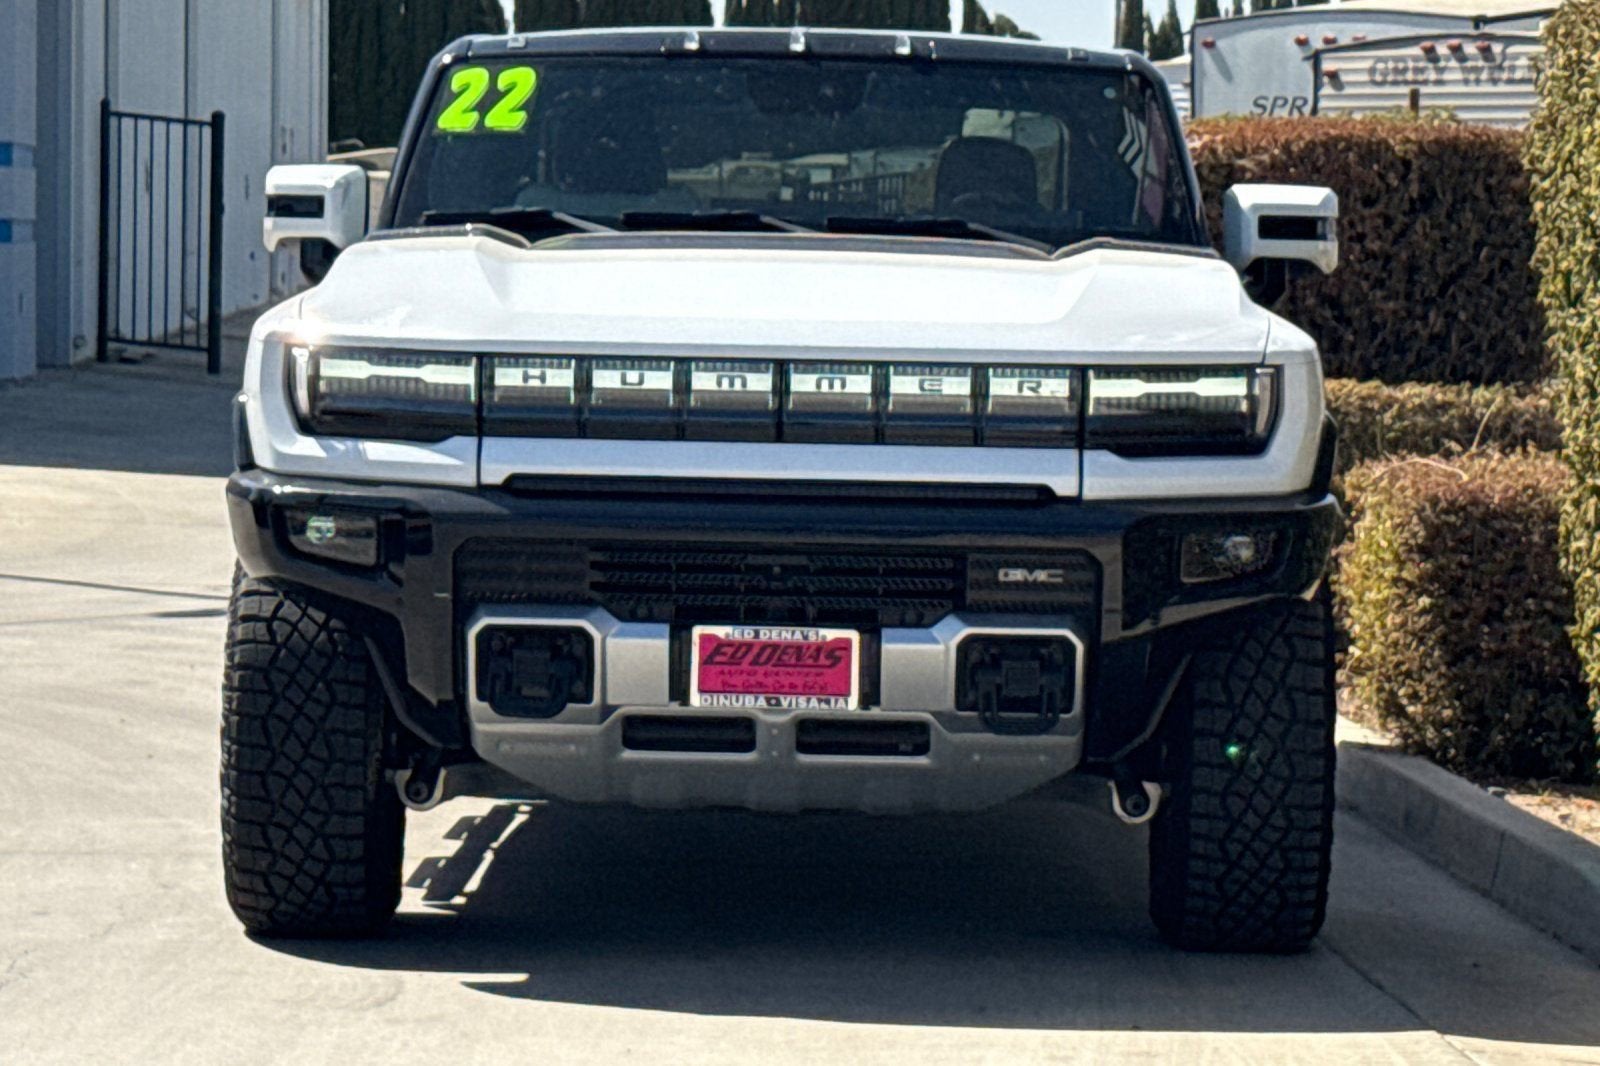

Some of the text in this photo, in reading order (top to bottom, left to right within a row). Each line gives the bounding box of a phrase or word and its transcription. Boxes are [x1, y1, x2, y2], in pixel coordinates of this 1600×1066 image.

[1368, 57, 1449, 86] GREY
[436, 66, 537, 132] 22
[1252, 95, 1308, 117] SPR
[522, 367, 1042, 395] HUMMER
[998, 568, 1064, 583] GMC
[733, 628, 819, 641] ED DENA'S
[703, 642, 754, 666] ED
